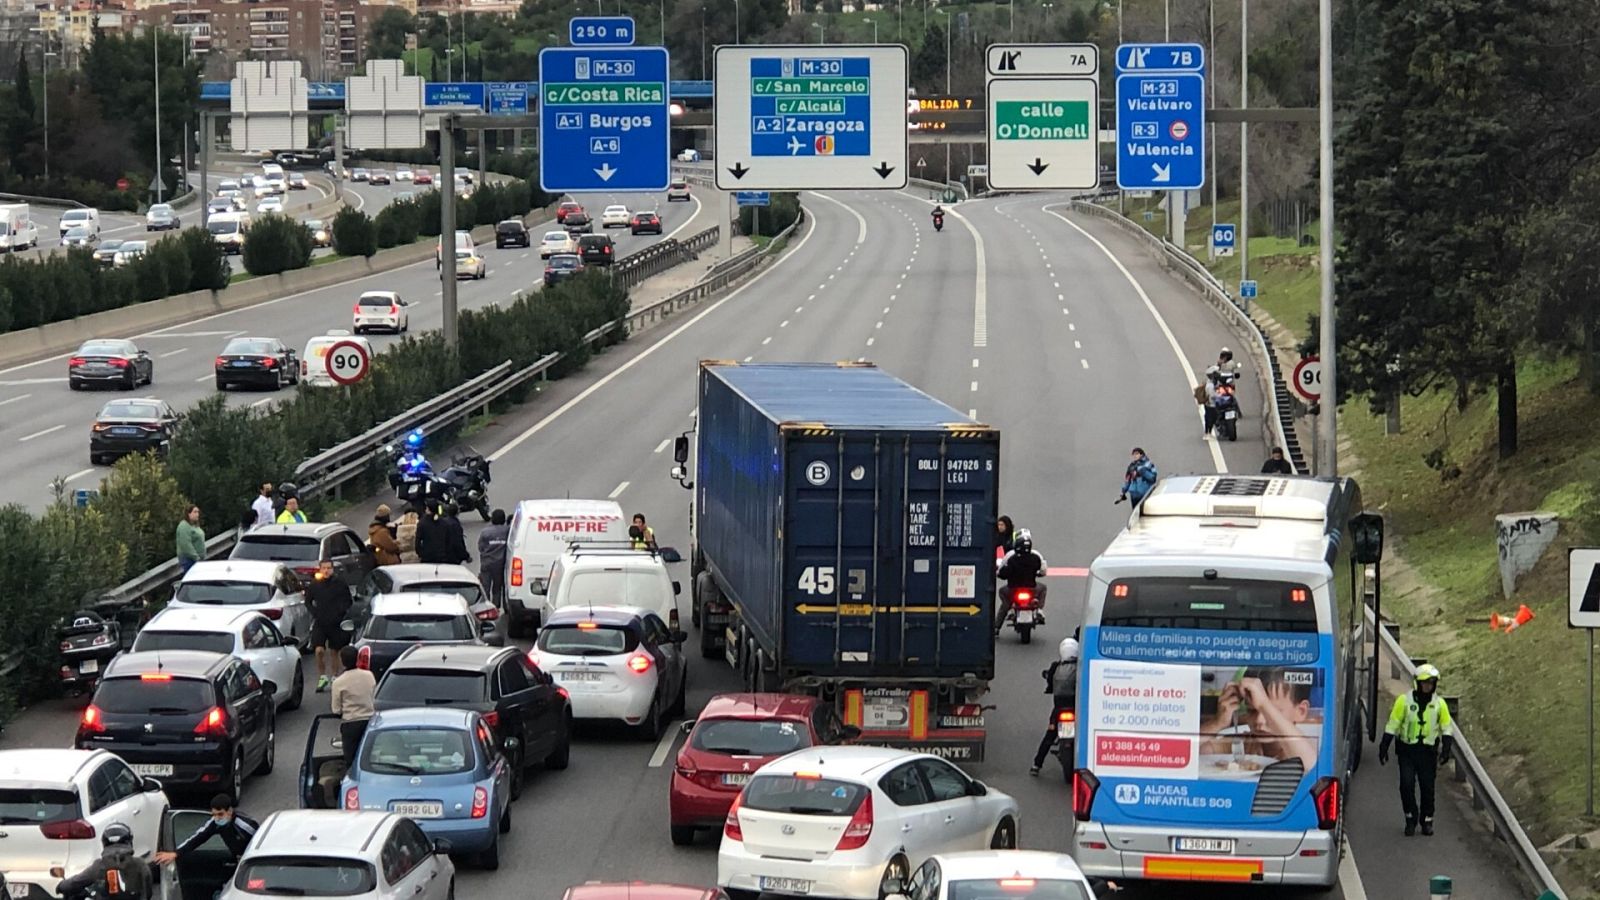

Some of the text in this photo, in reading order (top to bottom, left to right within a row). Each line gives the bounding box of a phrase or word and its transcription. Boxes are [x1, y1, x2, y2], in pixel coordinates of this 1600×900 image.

[576, 26, 628, 38] 250 m
[1070, 55, 1087, 66] 7A
[1171, 51, 1193, 66] 7B
[595, 62, 633, 74] M-30
[802, 61, 840, 74] M-30
[755, 81, 866, 93] c/San Marcelo
[1143, 83, 1176, 94] M-23
[548, 87, 661, 102] c/Costa Rica
[779, 100, 841, 112] c/Alcalá
[920, 99, 973, 110] SALIDA 7
[1021, 102, 1064, 117] calle
[1127, 98, 1193, 111] Vicálvaro
[559, 114, 652, 131] A-1 Burgos
[757, 118, 865, 134] A-2 Zaragoza
[998, 123, 1087, 138] O'Donnell
[1134, 124, 1156, 136] R-3
[593, 140, 618, 152] A-6
[1127, 142, 1194, 156] Valencia
[1214, 229, 1233, 242] 60
[334, 354, 360, 370] 90
[918, 459, 992, 471] BOLU 947926 5
[537, 521, 608, 533] MAPFRE
[950, 567, 974, 577] CAUTION
[798, 566, 835, 595] 45
[1101, 631, 1308, 653] Miles de familias no pueden asegurar
[1101, 647, 1122, 656] una
[1124, 646, 1196, 659] alimentación
[1254, 653, 1261, 661] a
[1263, 653, 1285, 662] sus
[1287, 650, 1313, 664] hijos
[1102, 683, 1187, 699] Únete al reto:
[1102, 700, 1186, 714] llenar los platos
[1102, 715, 1181, 728] de 2.000 niños
[905, 746, 971, 758] OMONTE
[1101, 741, 1112, 750] 91
[1135, 742, 1147, 752] 45
[1148, 743, 1161, 752] 49
[1101, 753, 1186, 765] aldeasinfantiles.es
[1144, 785, 1188, 796] ALDEAS
[1144, 797, 1233, 808] INFANTILES SOS
[396, 804, 440, 815] 8982 GLV
[1183, 839, 1207, 850] 1360
